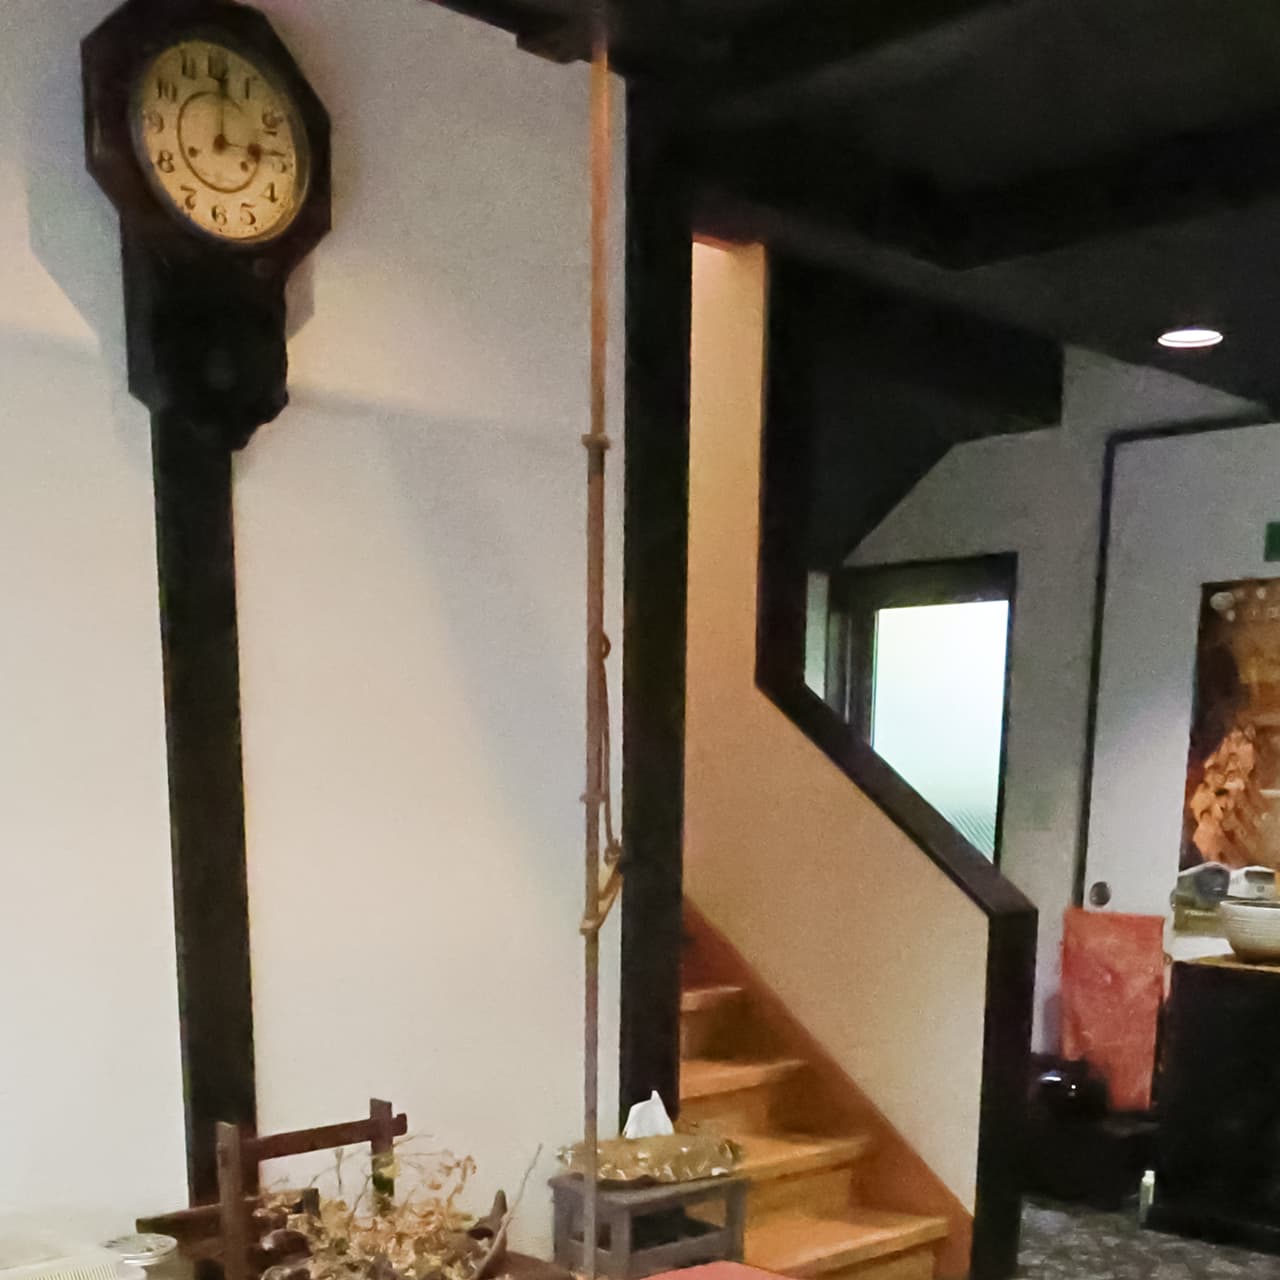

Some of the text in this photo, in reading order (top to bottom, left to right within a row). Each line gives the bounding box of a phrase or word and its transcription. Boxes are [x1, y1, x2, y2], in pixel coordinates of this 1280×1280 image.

[261, 108, 282, 137] 2
[157, 150, 176, 174] 8
[180, 184, 197, 210] 7
[260, 181, 279, 204] 4
[211, 204, 228, 227] 6
[239, 202, 258, 226] 5
